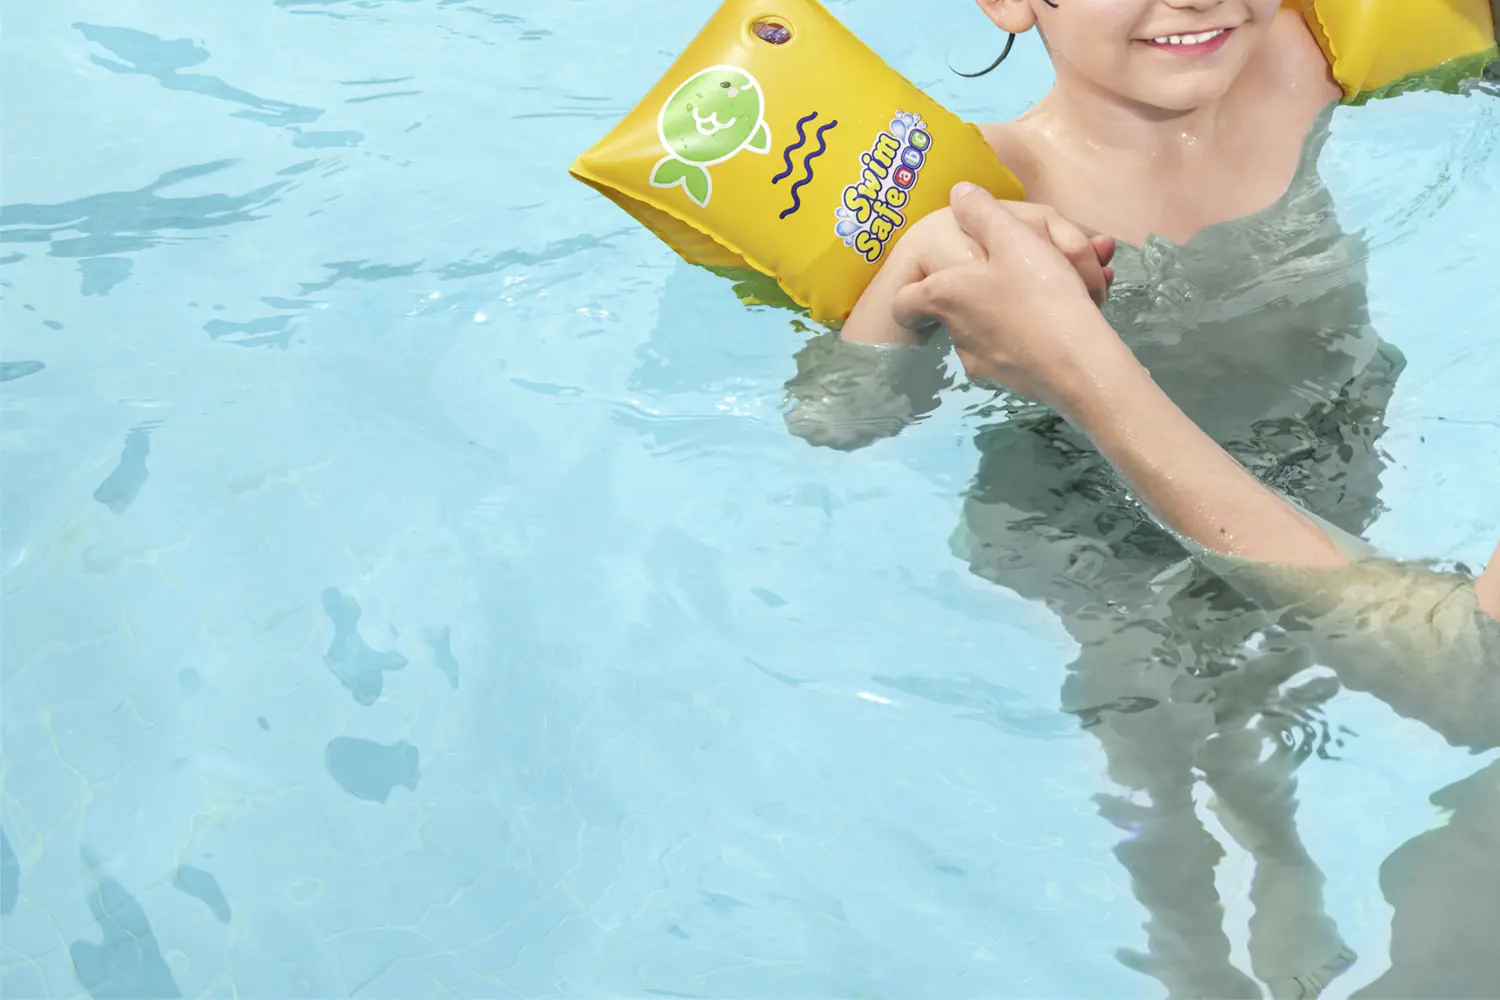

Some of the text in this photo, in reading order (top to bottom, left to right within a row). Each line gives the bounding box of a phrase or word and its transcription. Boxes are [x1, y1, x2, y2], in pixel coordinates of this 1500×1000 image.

[844, 133, 900, 223] Swim
[855, 128, 931, 262] Safe abc
